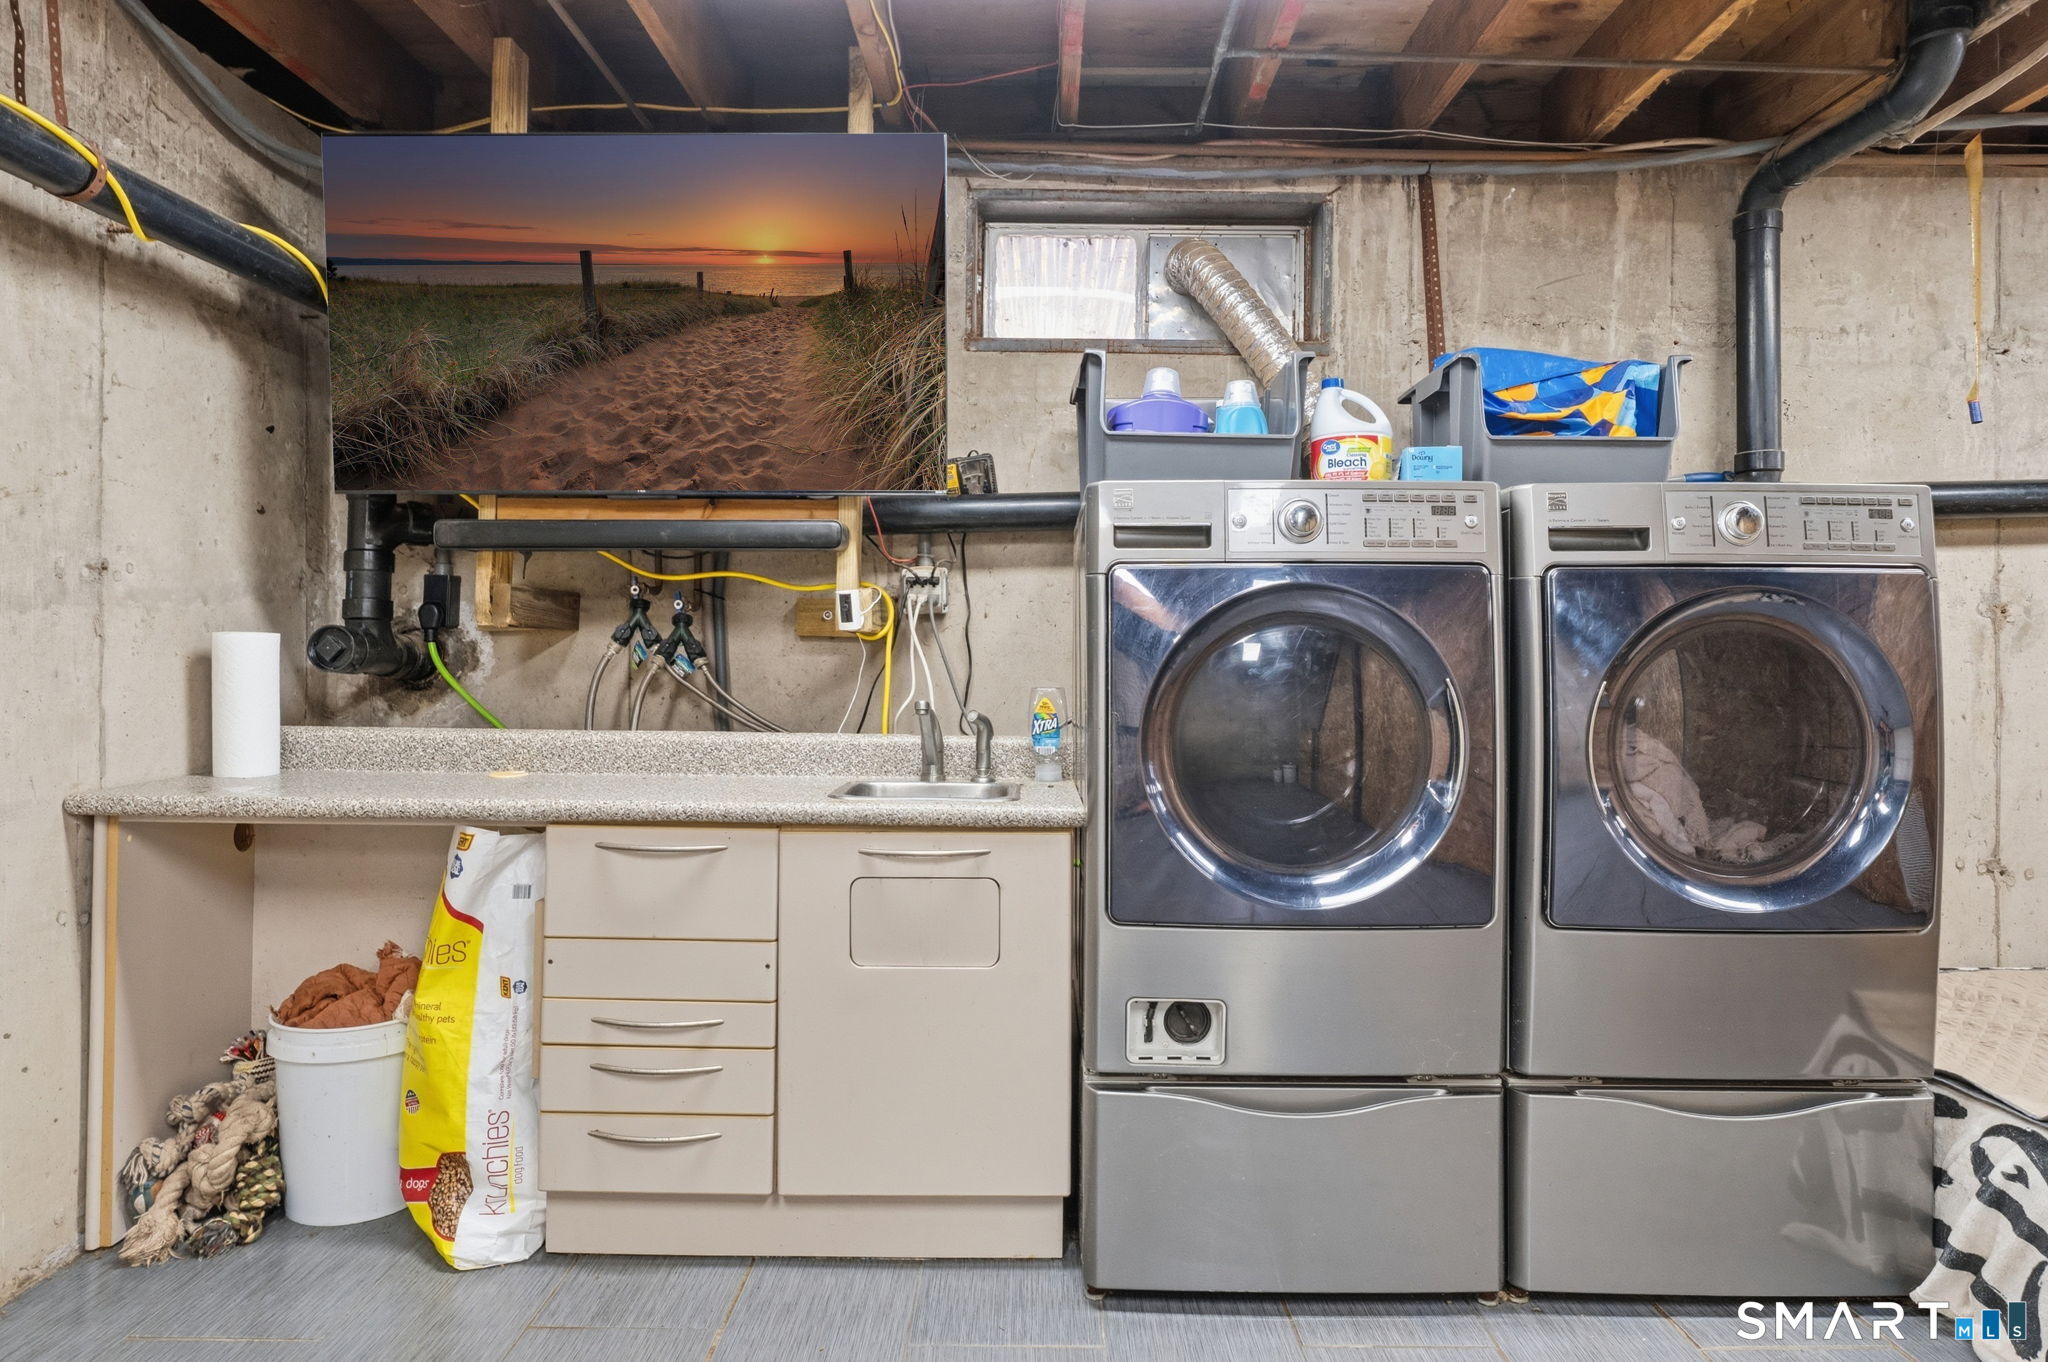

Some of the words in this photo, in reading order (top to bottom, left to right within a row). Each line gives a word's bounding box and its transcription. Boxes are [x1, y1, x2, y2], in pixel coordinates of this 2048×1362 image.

[1327, 457, 1367, 469] Bleach
[1411, 454, 1434, 463] Downy
[1032, 718, 1057, 735] XTRA
[437, 1015, 456, 1024] pets
[479, 1109, 510, 1216] krunchies
[514, 1146, 524, 1166] food
[513, 1166, 525, 1185] dog
[405, 1177, 430, 1192] dogs
